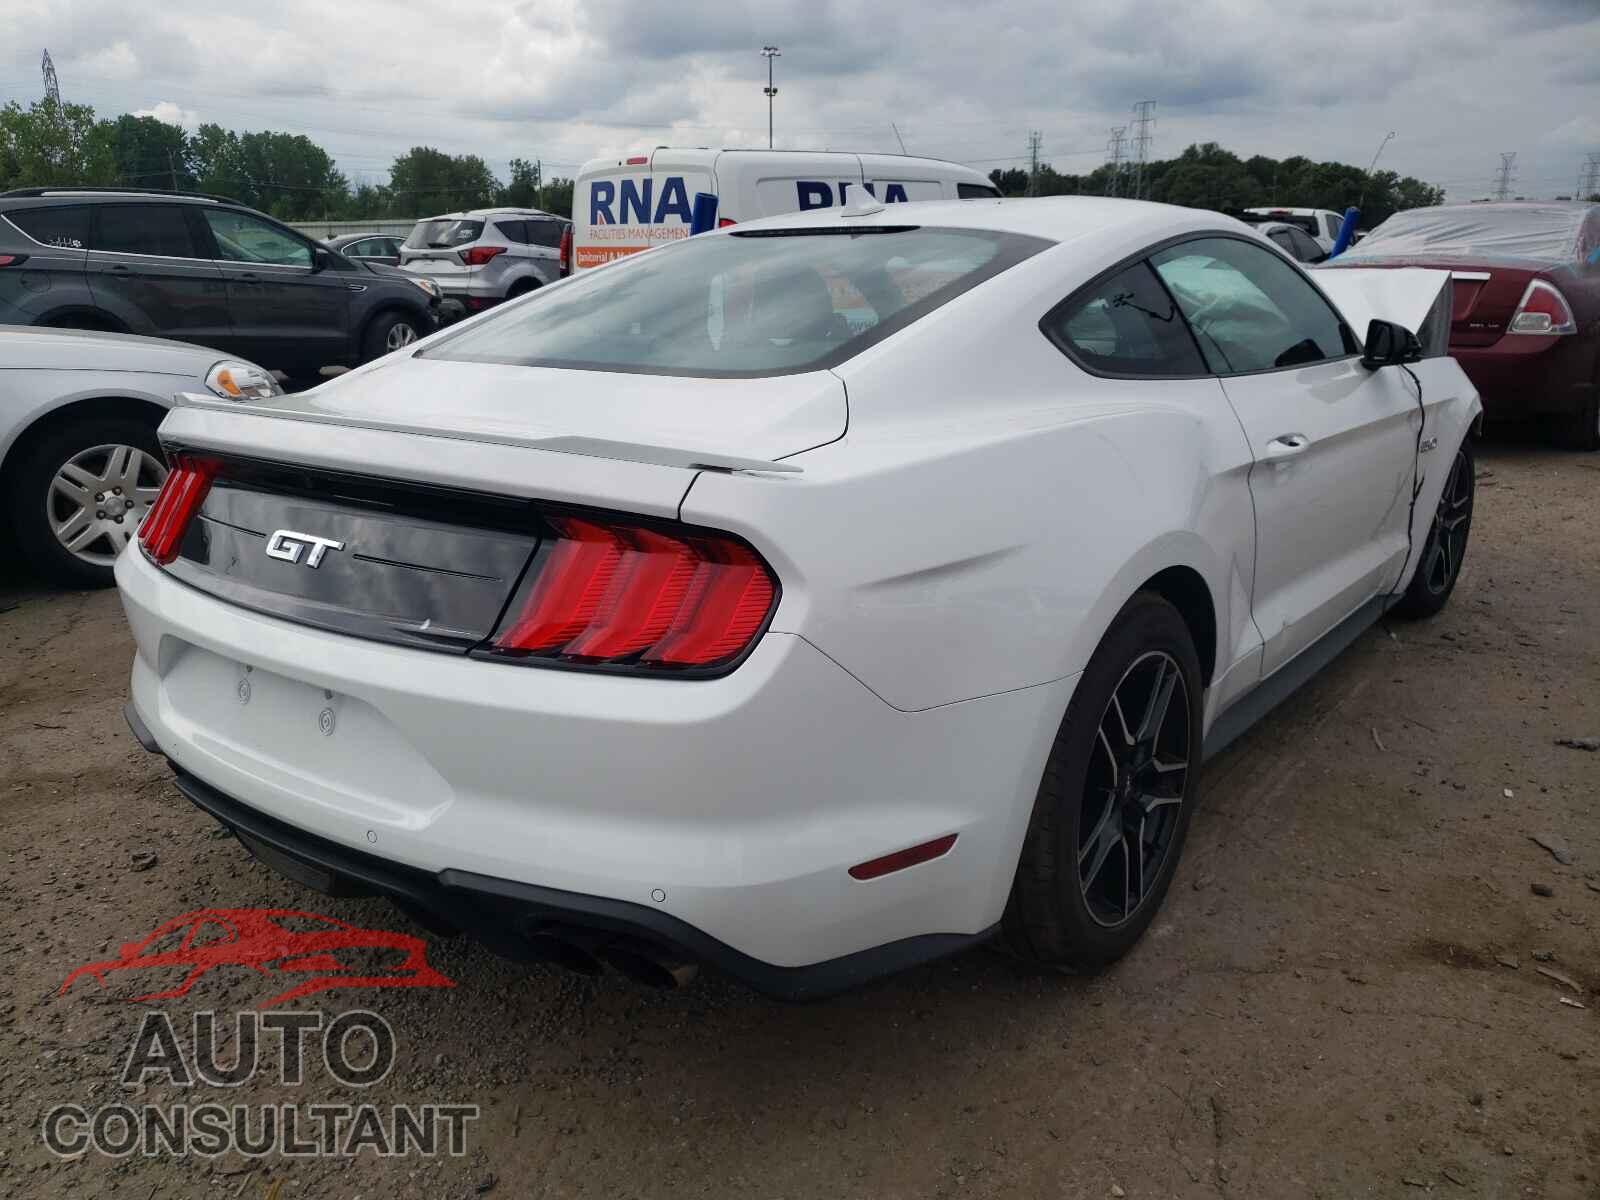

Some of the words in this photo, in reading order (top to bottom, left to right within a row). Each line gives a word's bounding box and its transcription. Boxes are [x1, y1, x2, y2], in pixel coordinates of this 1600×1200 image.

[591, 177, 694, 225] RNA
[627, 227, 689, 239] MANAGEMEN
[266, 529, 346, 569] GT
